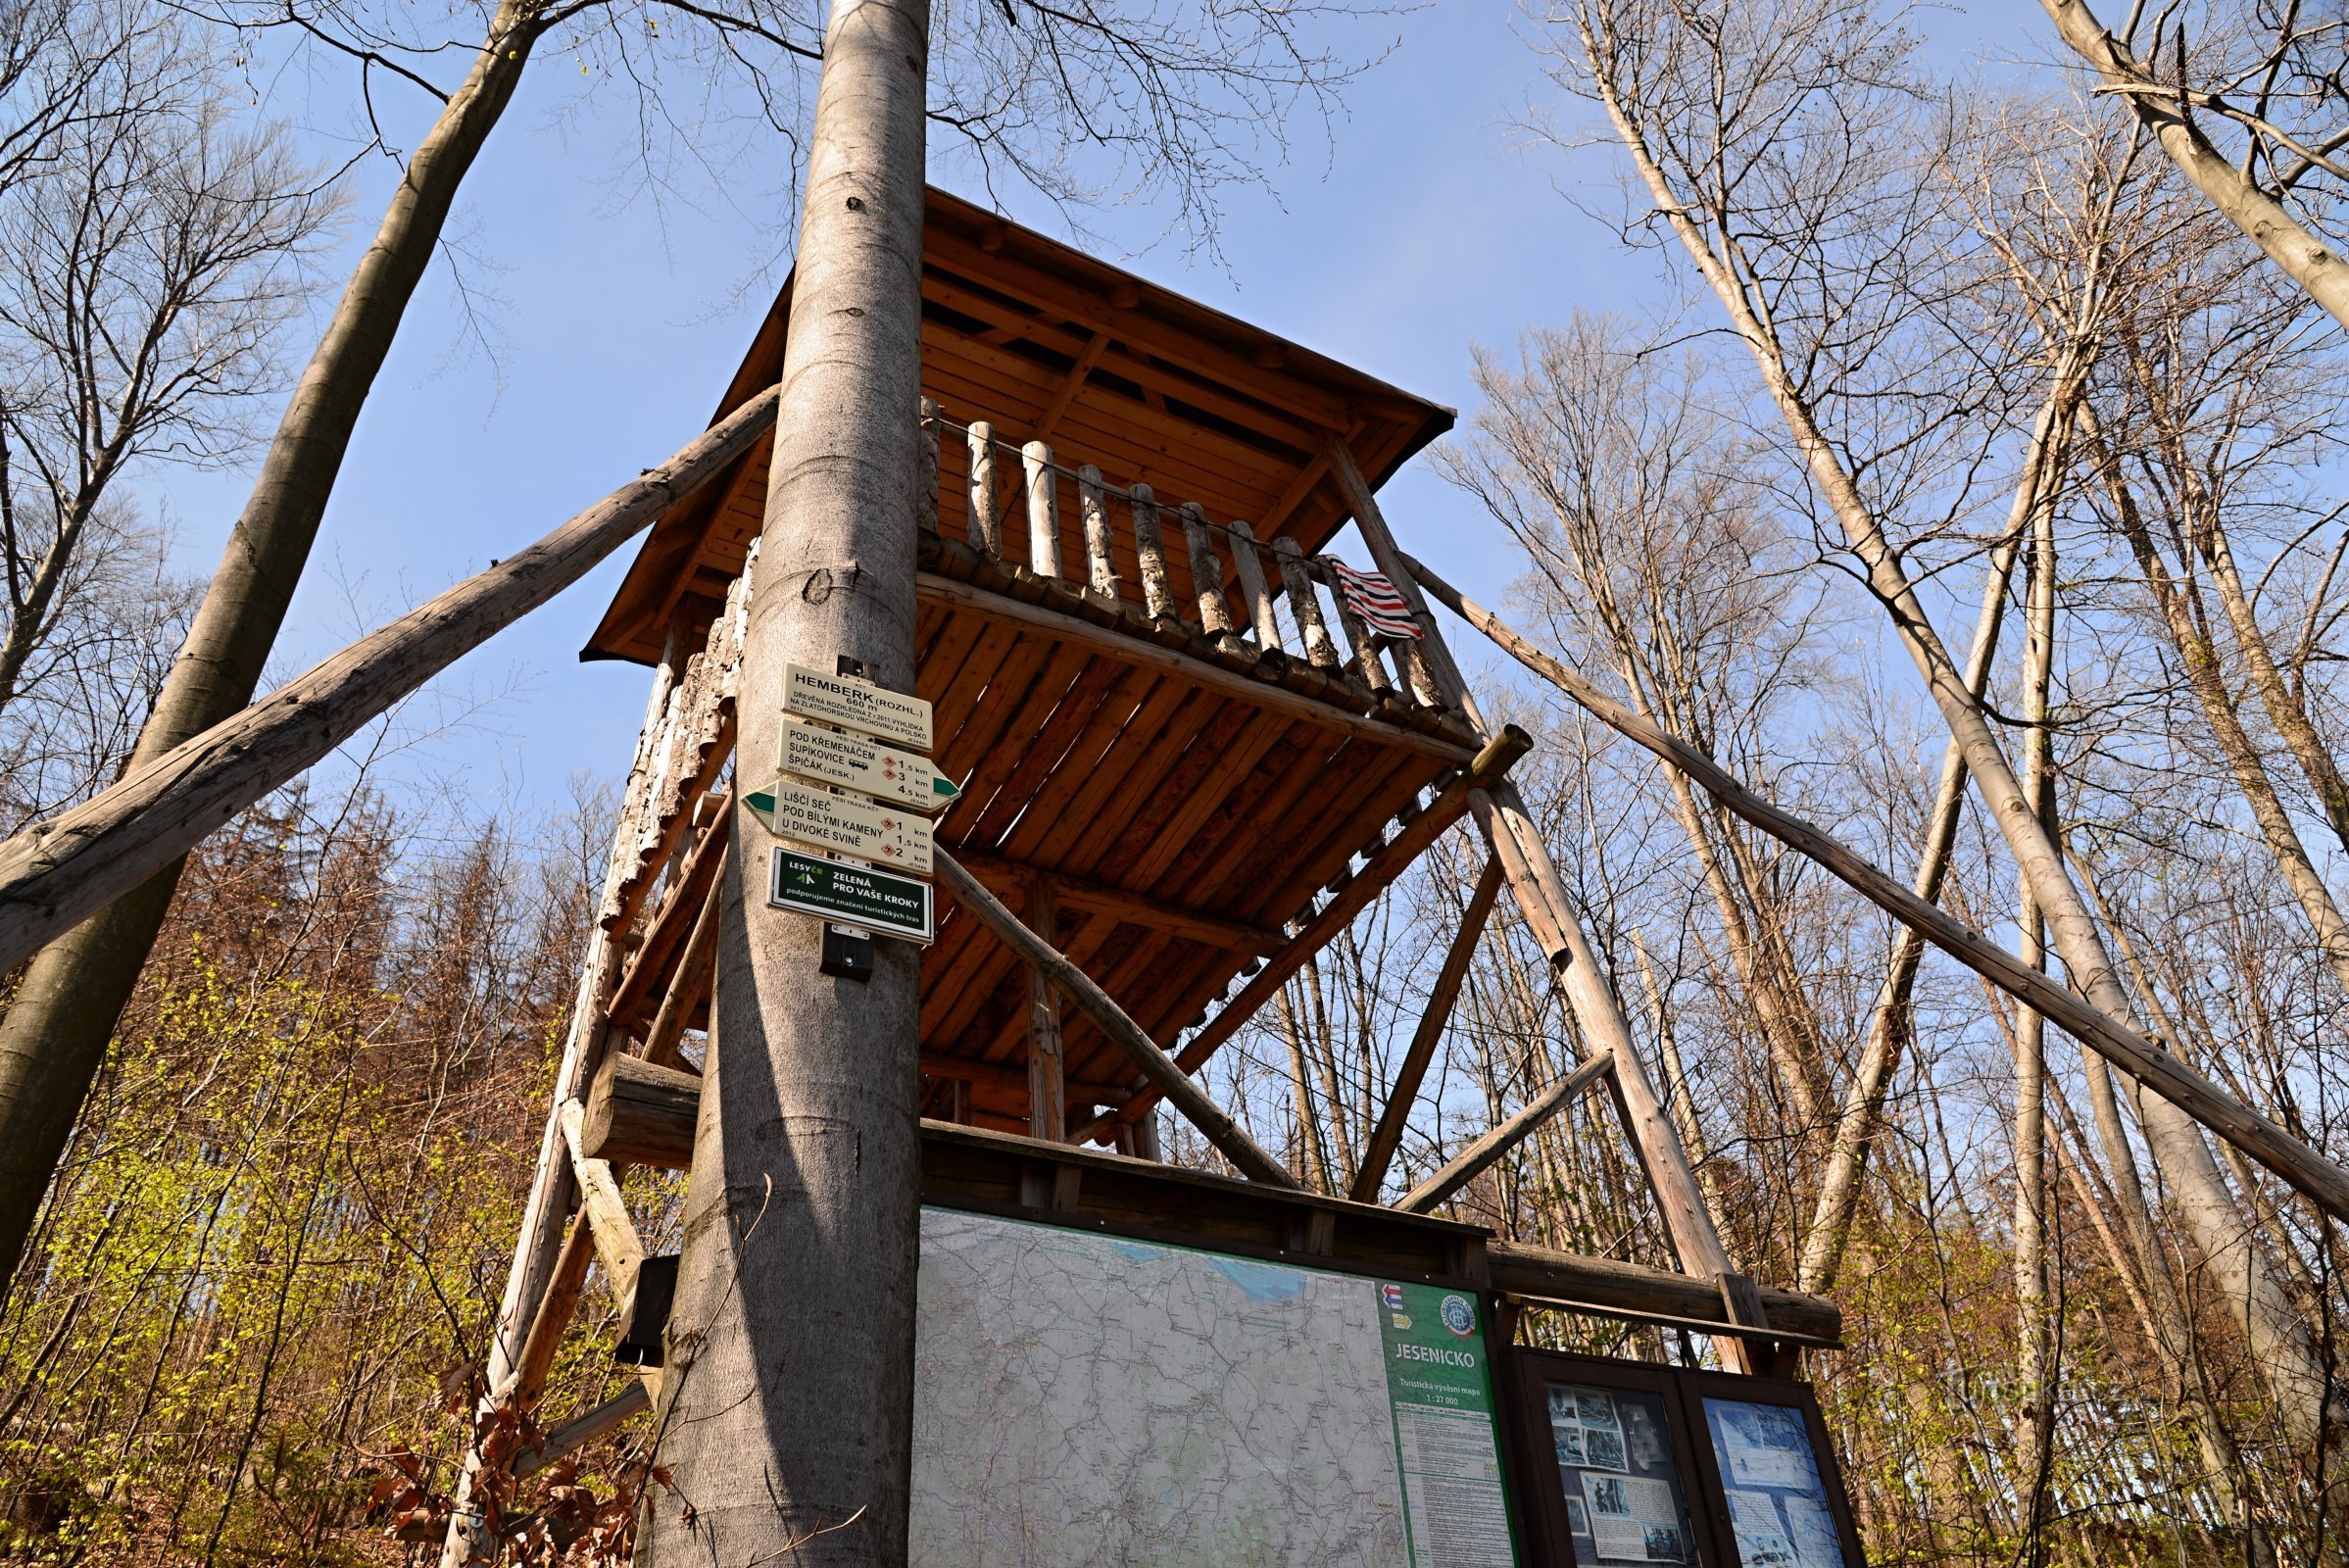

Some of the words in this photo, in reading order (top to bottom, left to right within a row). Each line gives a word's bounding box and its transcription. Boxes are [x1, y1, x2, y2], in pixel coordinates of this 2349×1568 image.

[793, 691, 825, 705] DŘEVĚNÁ
[826, 701, 866, 715] ROZHLEDNA
[795, 673, 873, 704] HEMBERK
[875, 698, 923, 718] (ROZHL.)
[846, 697, 864, 708] 660
[790, 697, 801, 706] NA
[801, 699, 855, 720] ZLATOHORSKOU
[856, 714, 893, 731] VRCHOVINU
[901, 727, 927, 740] POLSKO
[790, 729, 809, 743] POD
[811, 735, 875, 760] KŘEMENÁČEM
[915, 766, 928, 775] km
[850, 738, 869, 748] TRASA
[788, 754, 823, 772] ŠPIČÁK
[824, 766, 855, 781] (JESK.)
[915, 791, 928, 800] km
[790, 742, 845, 764] SUPÍKOVICE
[899, 772, 905, 781] 3
[915, 779, 928, 788] km
[784, 791, 809, 805] LIŠČÍ
[811, 798, 831, 811] SEČ
[897, 821, 902, 831] 1
[914, 828, 928, 838] km
[847, 800, 865, 808] TRASA
[782, 818, 789, 828] U
[792, 820, 829, 839] DIVOKÉ
[832, 831, 861, 847] SVINĚ
[896, 848, 904, 858] 2
[913, 855, 928, 863] km
[784, 805, 804, 817] POD
[807, 808, 840, 828] BÍLÝMI
[843, 819, 883, 839] KAMENY
[914, 842, 928, 851] km
[833, 871, 871, 888] ZELENÁ
[786, 887, 835, 904] podporujeme
[836, 898, 863, 910] značení
[864, 904, 905, 920] turistických
[905, 914, 919, 923] tras
[833, 882, 855, 894] PRO
[856, 887, 882, 901] VAŠE
[884, 893, 919, 909] KROKY
[1395, 1343, 1475, 1368] JESENICKO
[1399, 1378, 1433, 1391] Turistická
[1435, 1382, 1460, 1394] vývěsní
[1461, 1386, 1481, 1396] mapa
[1444, 1396, 1458, 1405] 000
